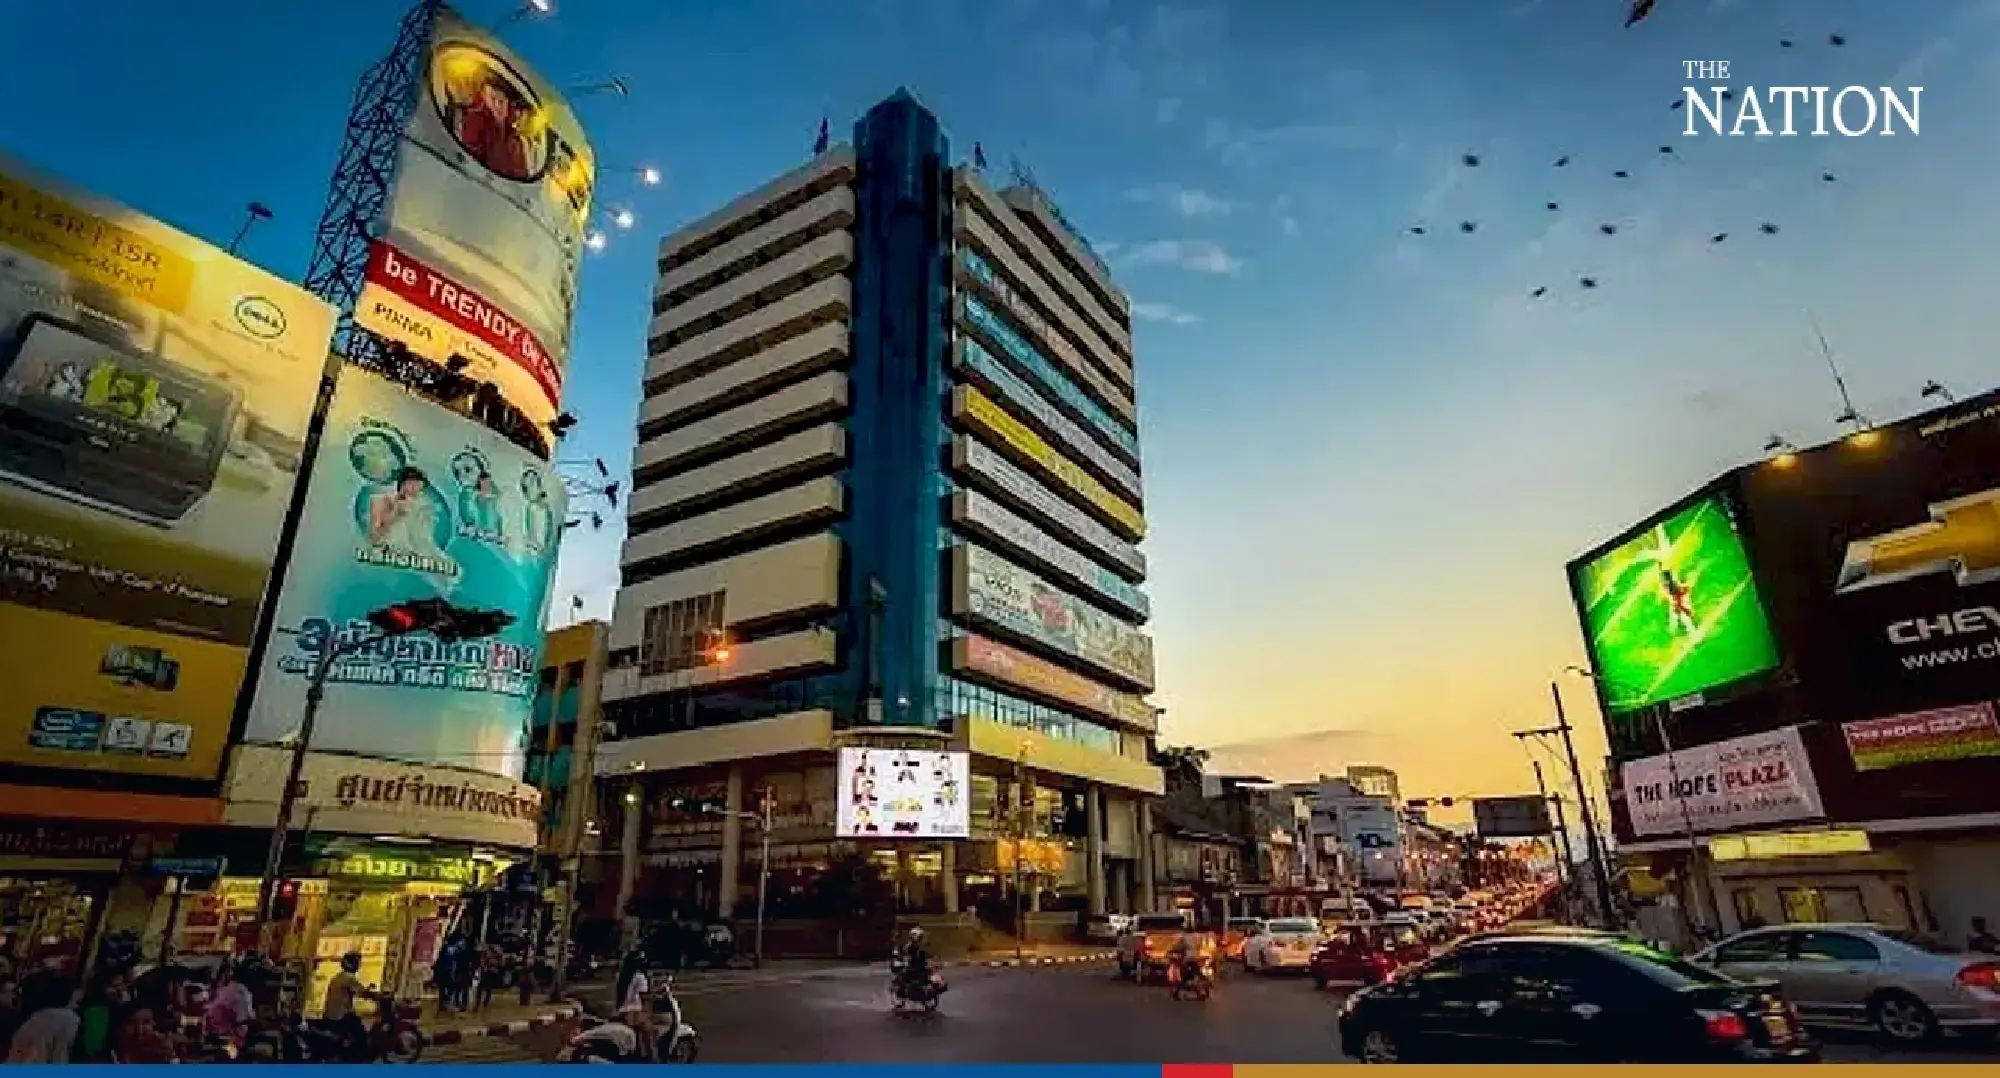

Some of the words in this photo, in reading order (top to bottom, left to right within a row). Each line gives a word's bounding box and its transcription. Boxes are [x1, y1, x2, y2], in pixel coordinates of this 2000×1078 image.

[385, 251, 418, 286] be
[426, 274, 522, 346] TRENDY
[1635, 780, 1663, 804] THE
